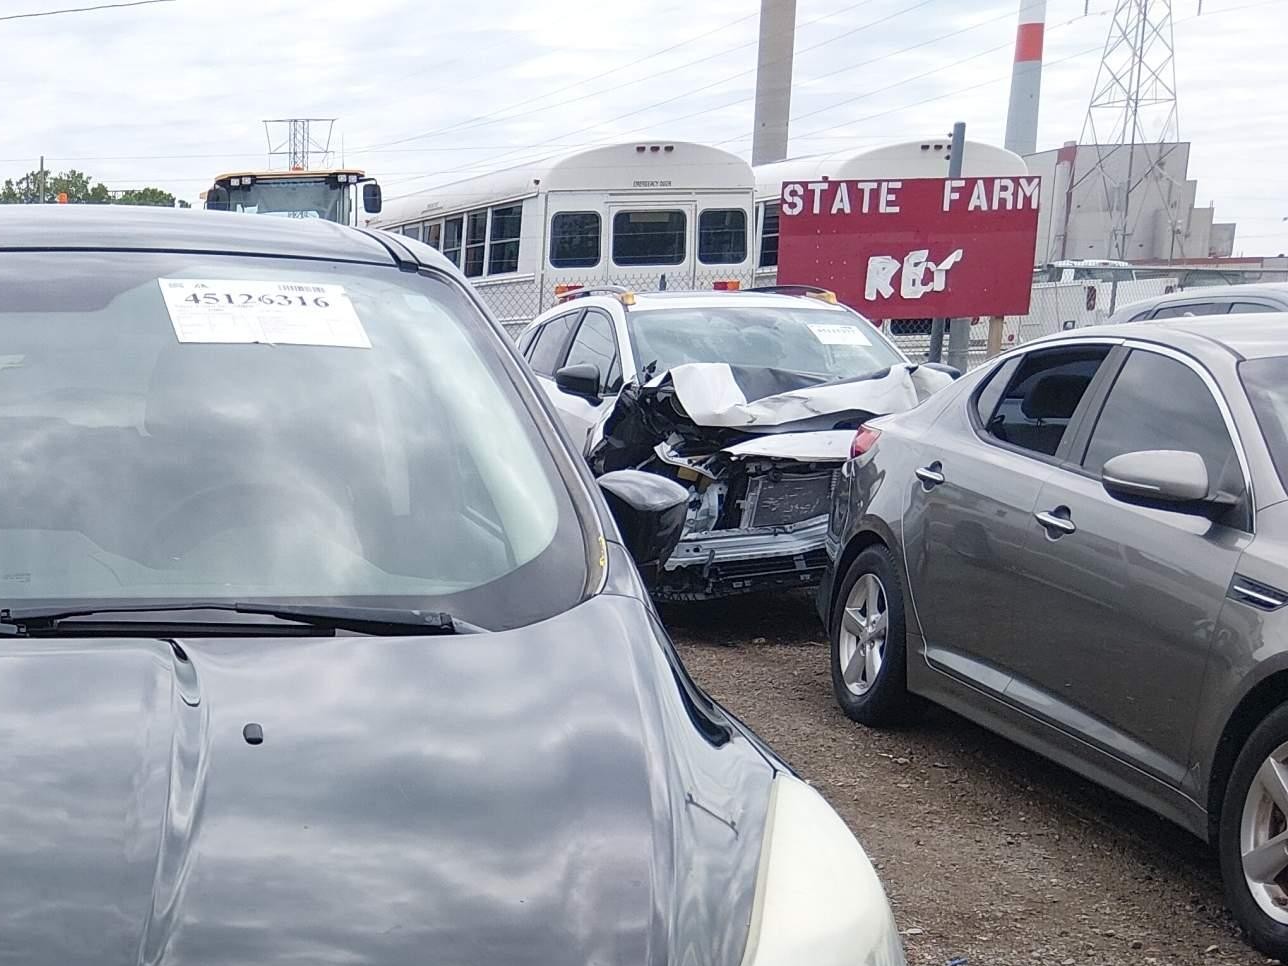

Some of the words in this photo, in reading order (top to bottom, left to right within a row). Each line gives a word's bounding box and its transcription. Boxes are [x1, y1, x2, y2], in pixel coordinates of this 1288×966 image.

[782, 182, 902, 216] STATE
[943, 178, 1040, 212] FARM
[185, 292, 330, 308] 45126316
